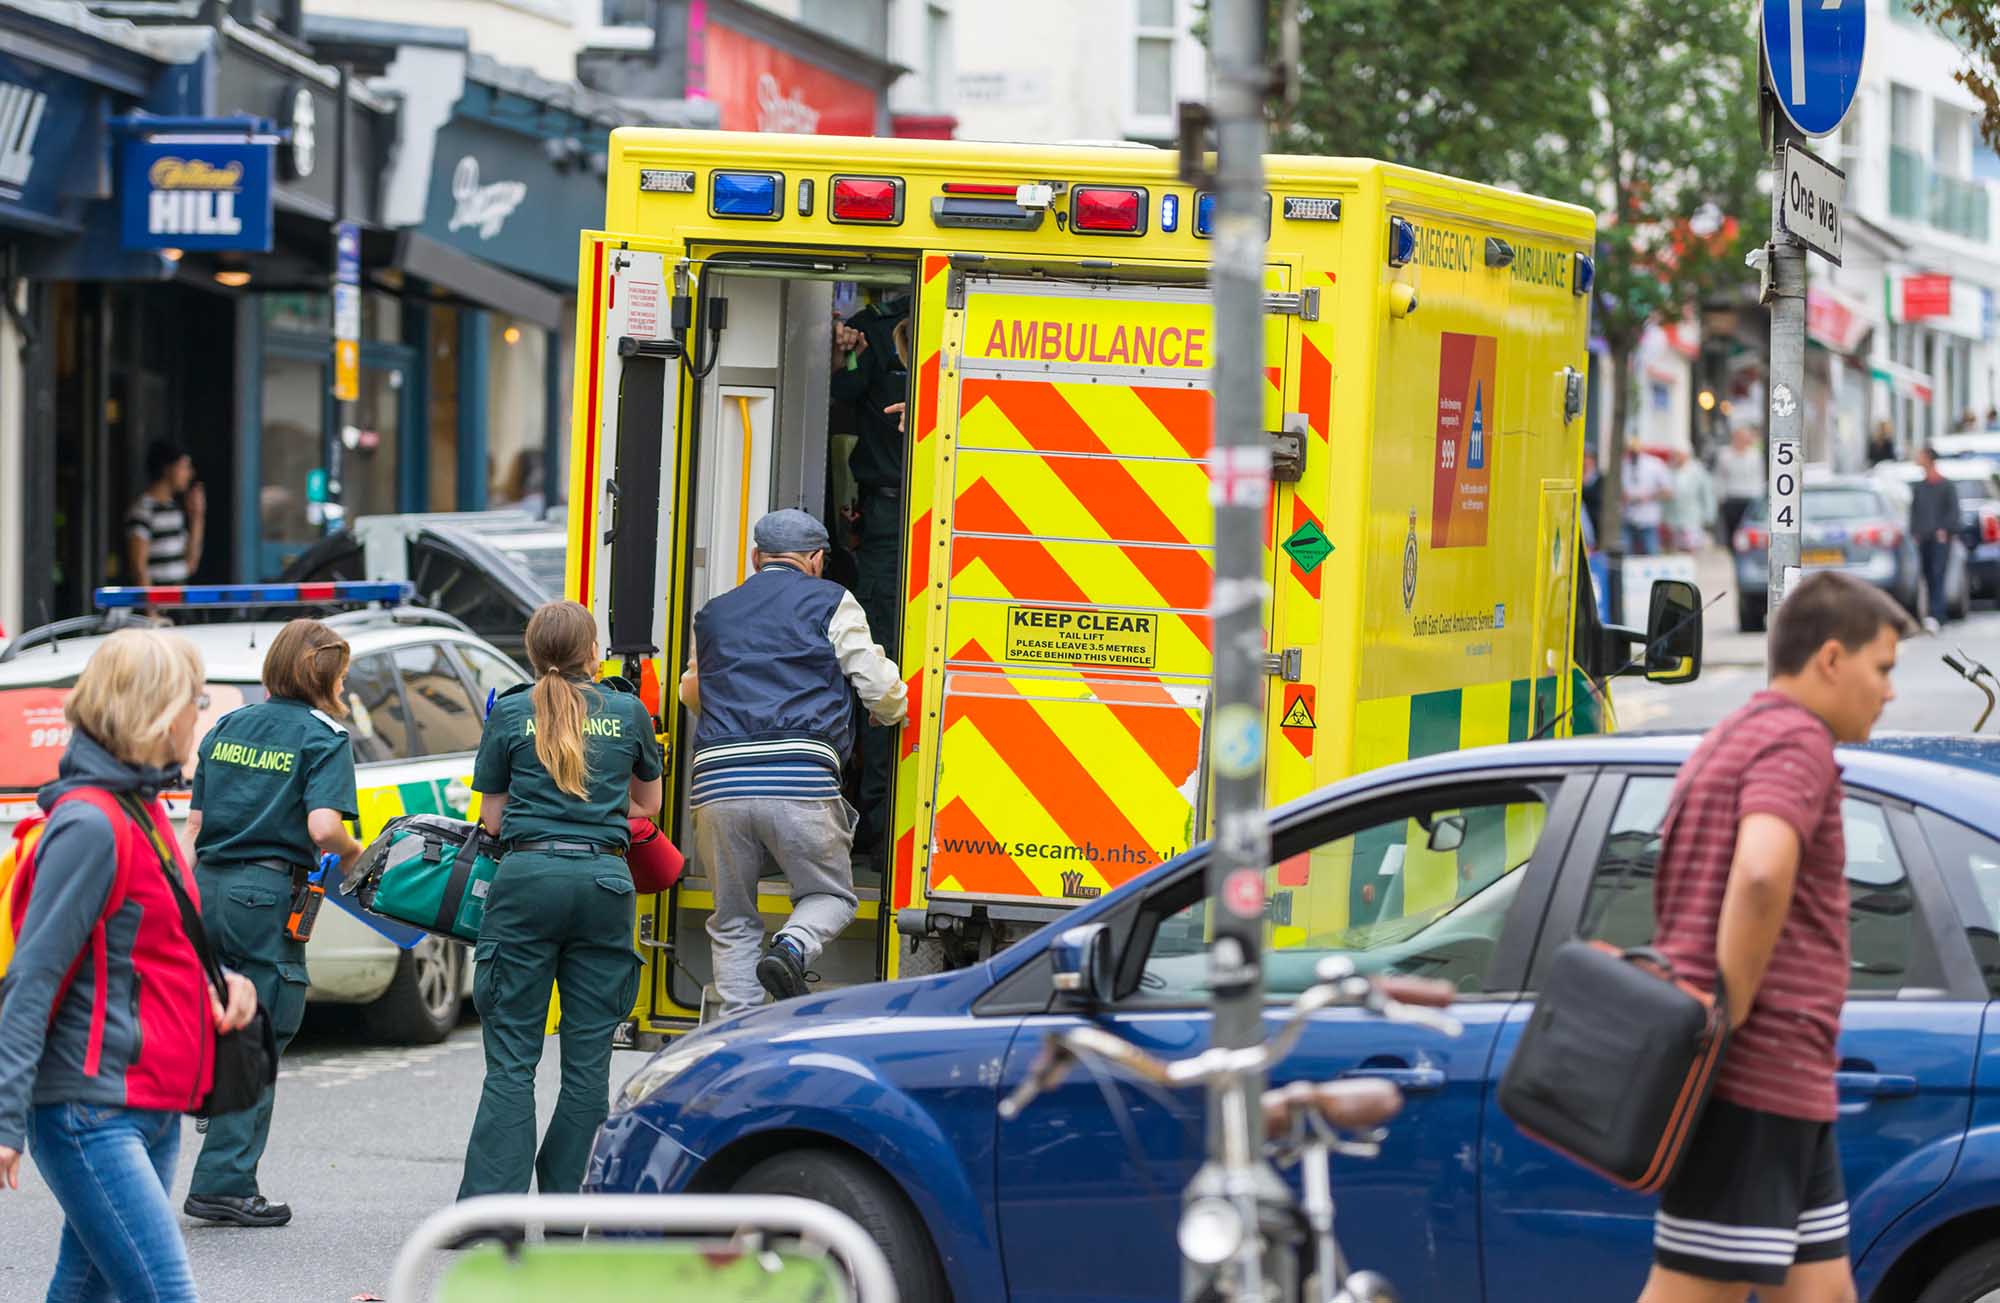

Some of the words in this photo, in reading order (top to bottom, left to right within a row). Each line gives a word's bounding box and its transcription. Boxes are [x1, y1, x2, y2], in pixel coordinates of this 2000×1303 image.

[148, 189, 243, 236] HILL
[1790, 170, 1815, 221] One
[1818, 196, 1838, 244] way
[1413, 224, 1475, 273] EMERGENCY
[1511, 243, 1566, 289] AMBULANCE
[984, 319, 1205, 368] AMBULANCE
[1441, 439, 1456, 469] 999
[1471, 431, 1483, 460] 111
[1014, 611, 1072, 628] KEEP
[1077, 615, 1150, 633] CLEAR
[1059, 631, 1081, 640] TAIL
[1083, 633, 1104, 641] LIFT
[1010, 649, 1042, 658] SPACE
[1044, 651, 1082, 660] BEHIND
[1084, 653, 1107, 661] THIS
[1109, 654, 1151, 664] VEHICLE
[1016, 639, 1053, 648] PLEASE
[1055, 641, 1088, 650] LEAVE
[1089, 643, 1104, 651] 3.5
[1105, 644, 1146, 654] METRES
[525, 718, 622, 738] AANCE
[210, 741, 295, 772] AMBULANCE
[1061, 870, 1101, 898] WILKER
